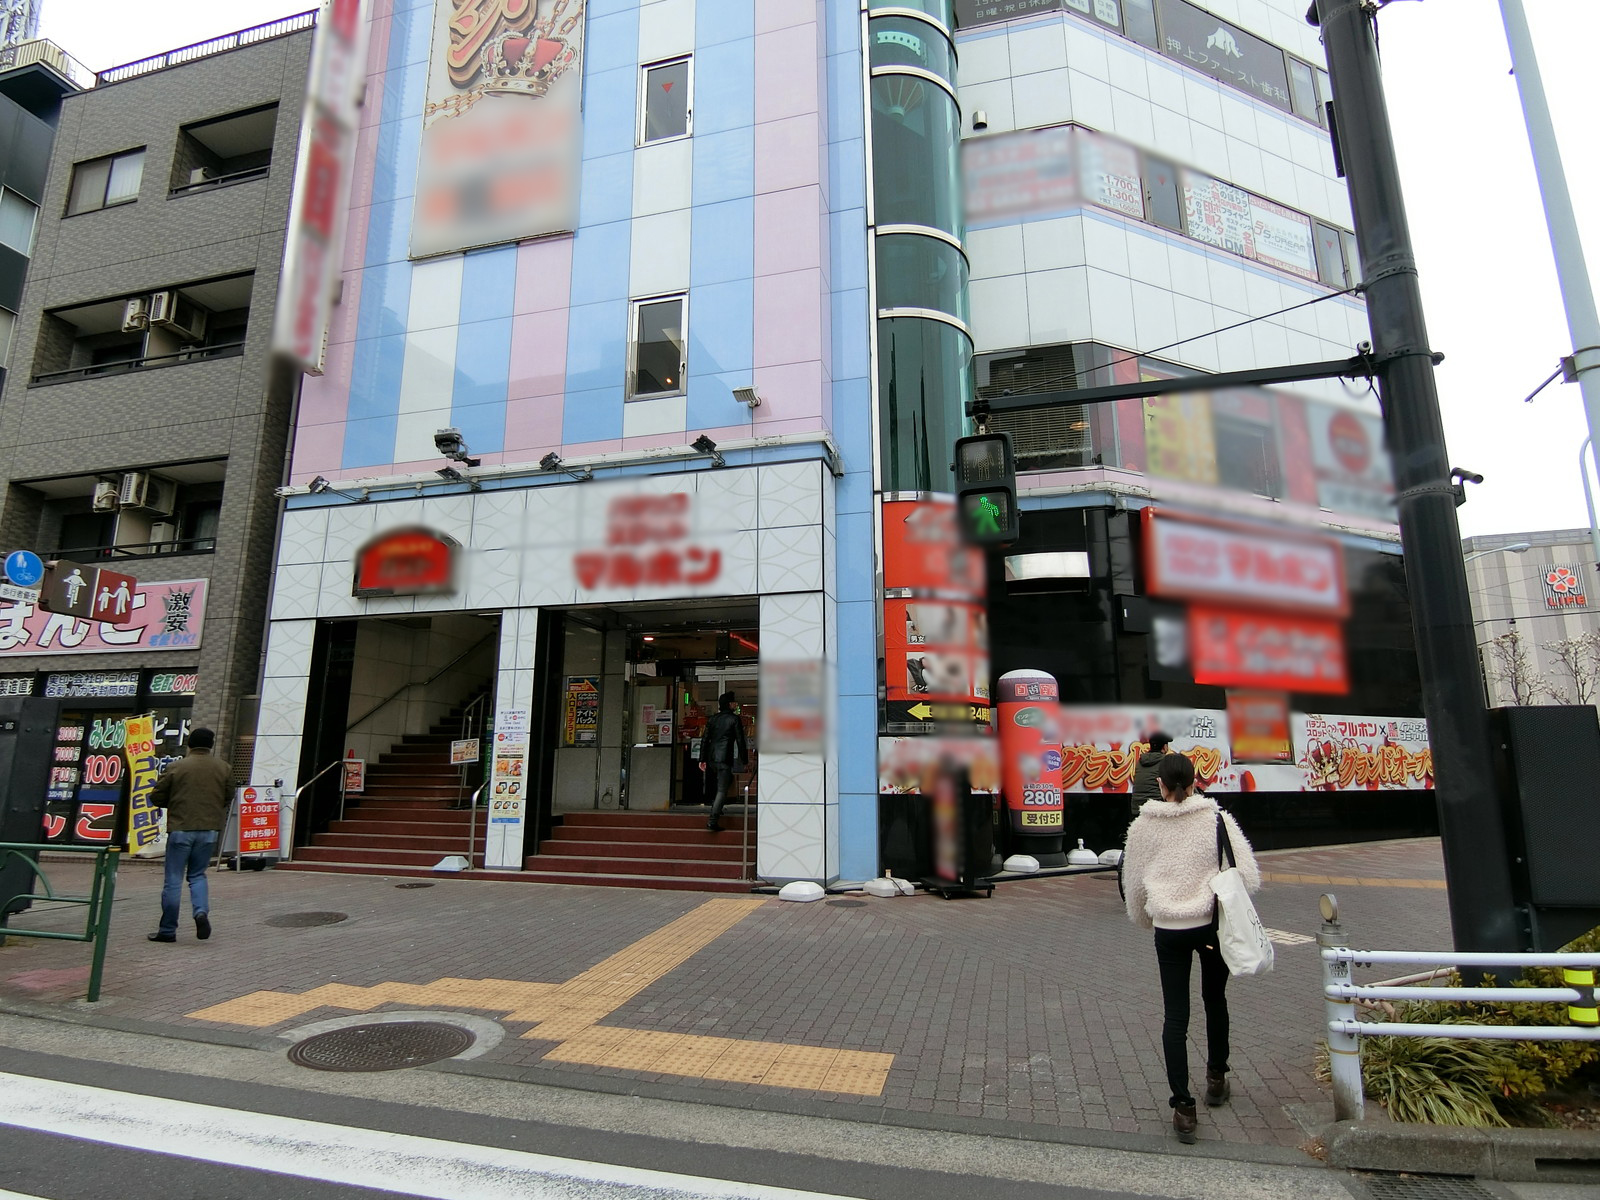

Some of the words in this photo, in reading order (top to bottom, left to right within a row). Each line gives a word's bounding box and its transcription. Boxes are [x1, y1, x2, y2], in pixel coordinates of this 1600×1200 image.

[1166, 35, 1289, 104] 押上ファースト歯科
[2, 587, 38, 602] 歩行者優先
[1547, 596, 1587, 607] LIFE
[167, 592, 191, 632] 激安
[150, 673, 198, 693] 宅配OK!
[1305, 720, 1327, 729] パチンコ
[1337, 721, 1377, 737] マルホン
[1306, 729, 1328, 737] スロット
[85, 754, 122, 784] 100
[241, 804, 279, 814] 21:00まで
[252, 816, 268, 826] 宅配
[1026, 813, 1061, 825] 受付5F
[243, 828, 277, 839] お持ち帰り
[249, 840, 271, 850] 実施中
